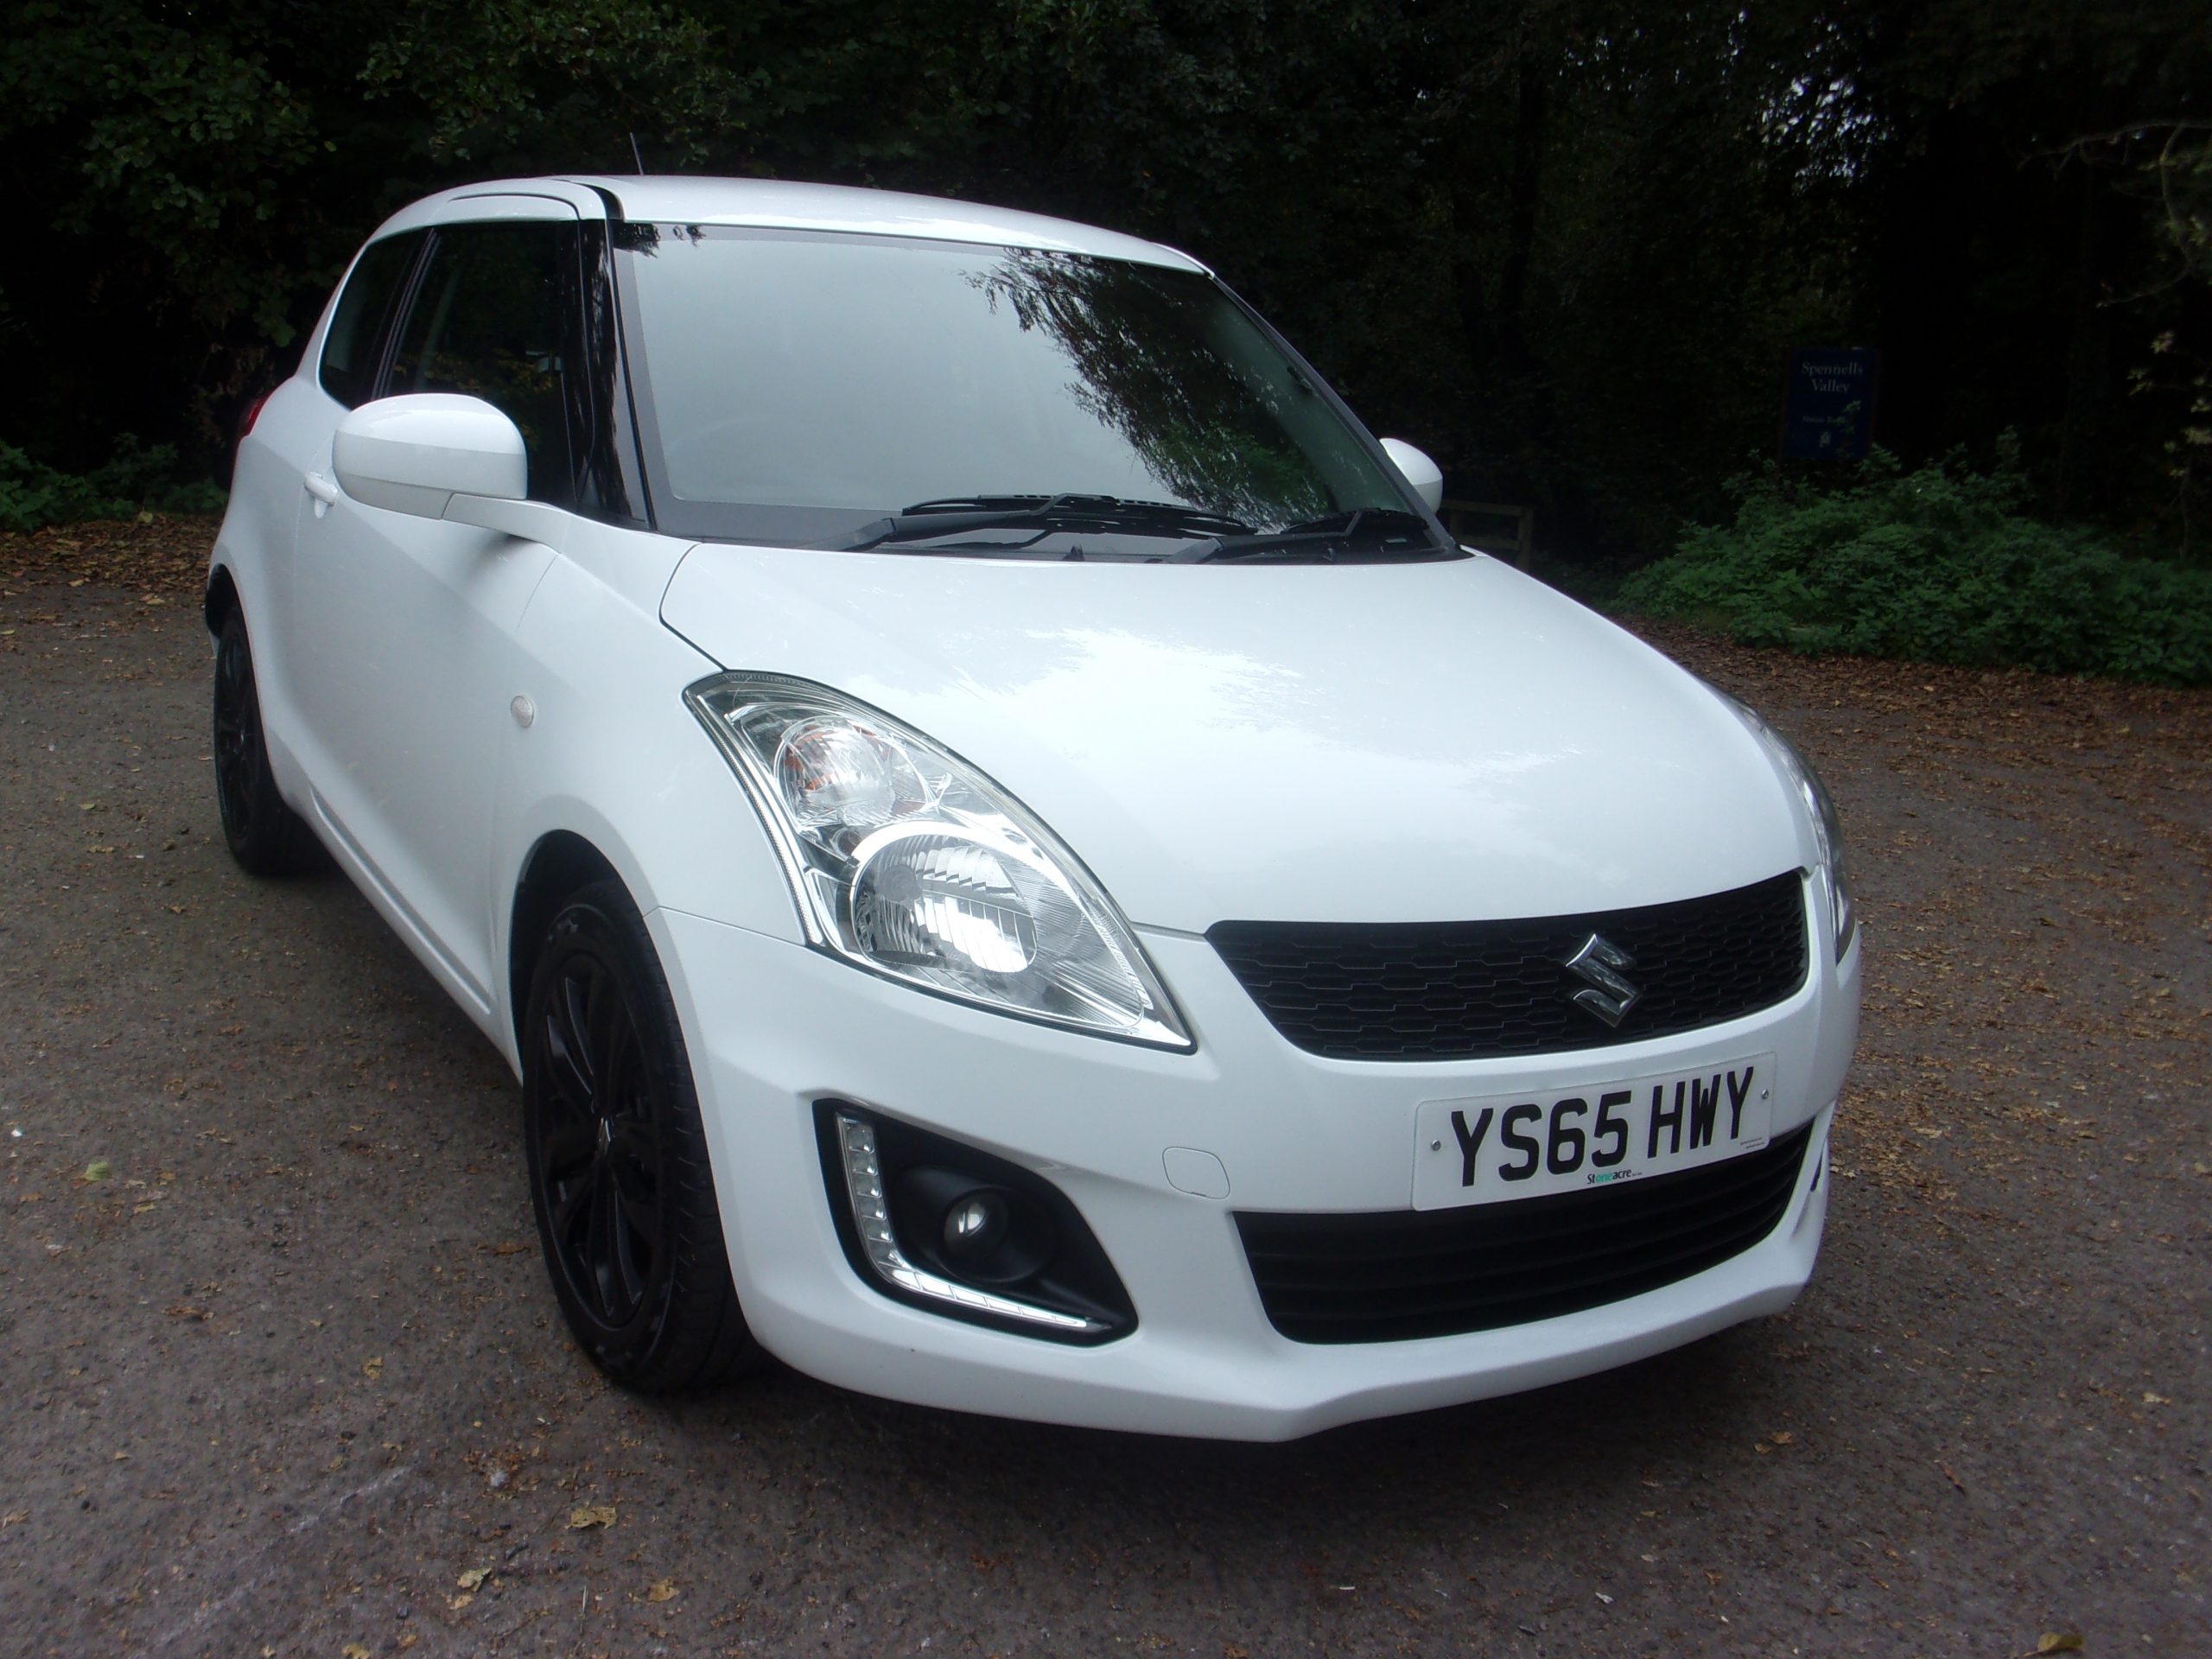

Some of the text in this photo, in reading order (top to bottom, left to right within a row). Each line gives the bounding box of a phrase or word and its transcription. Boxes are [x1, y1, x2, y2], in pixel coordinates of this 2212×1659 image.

[1801, 361, 1864, 377] Spennells
[1811, 378, 1851, 394] Valley
[1450, 1065, 1755, 1188] YS65 HWY
[1586, 1169, 1632, 1185] Stoneacre
